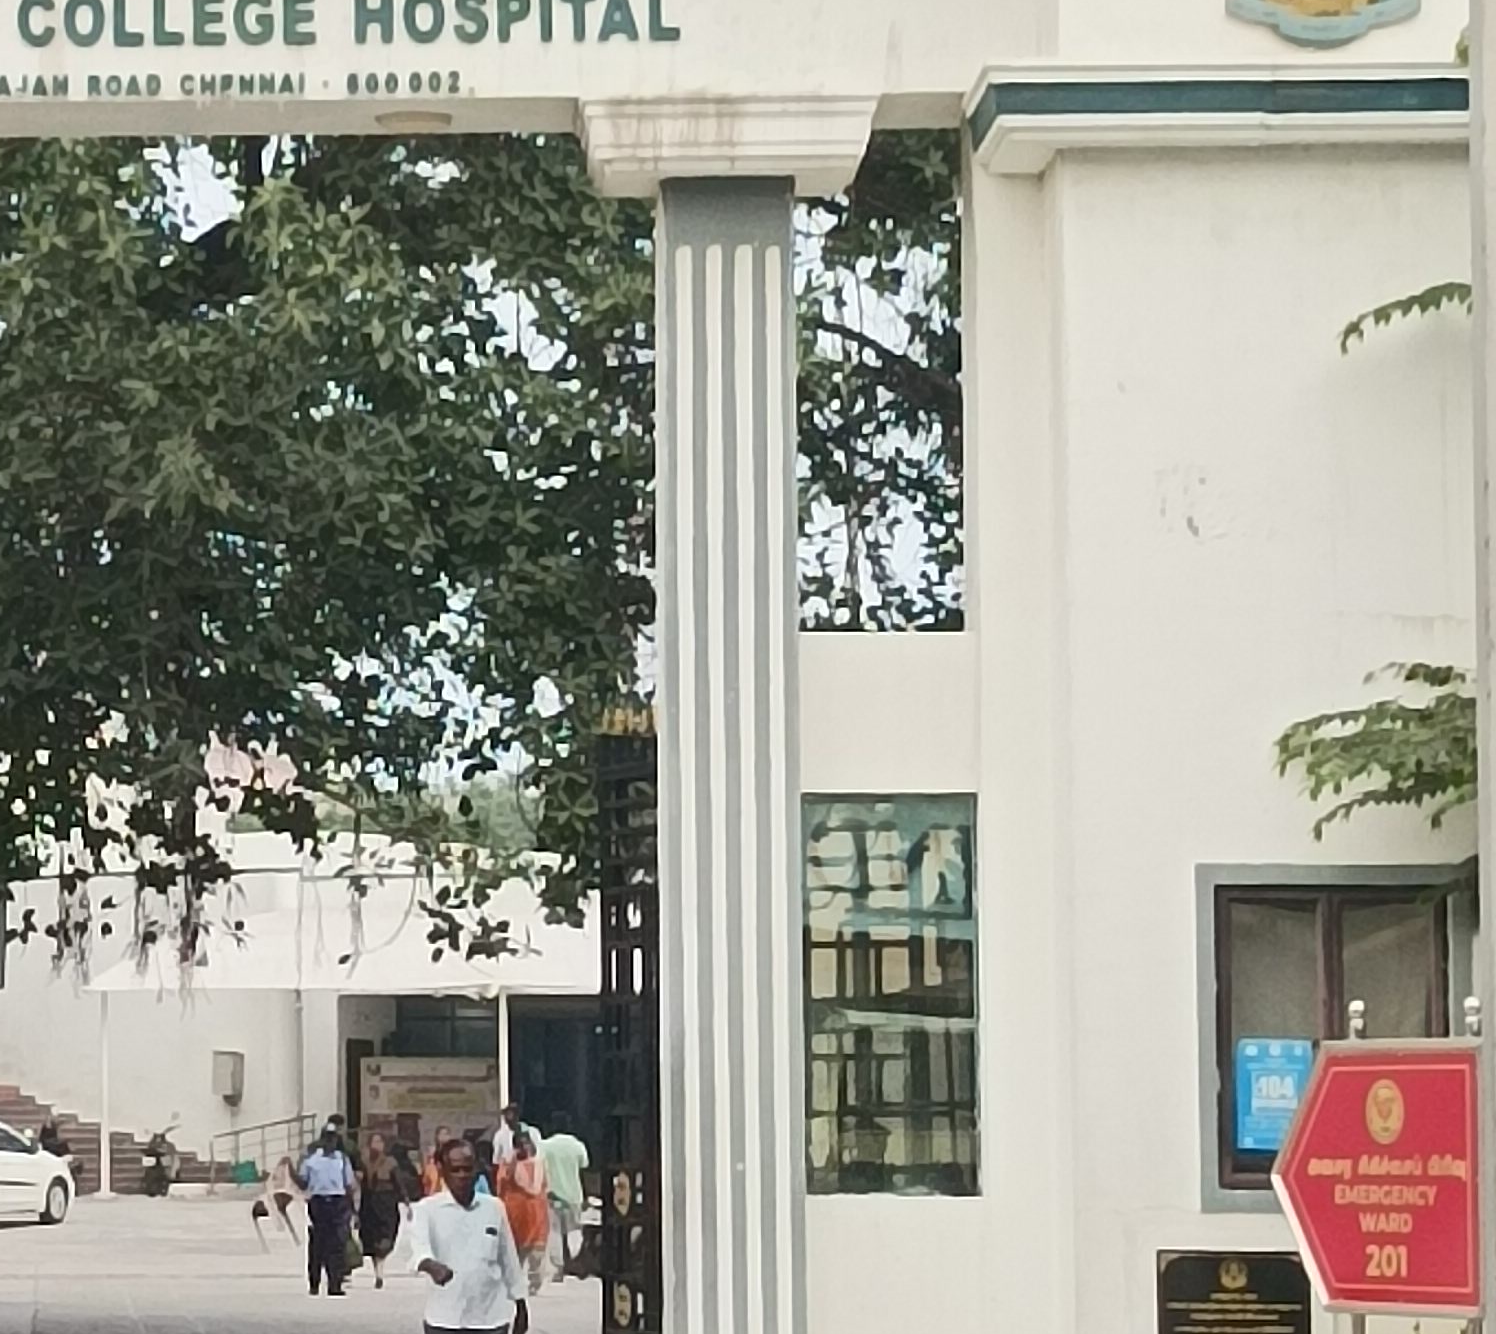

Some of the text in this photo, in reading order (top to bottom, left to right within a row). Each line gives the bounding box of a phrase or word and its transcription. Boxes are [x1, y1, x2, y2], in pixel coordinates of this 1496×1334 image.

[87, 73, 162, 97] ROAD
[1334, 1184, 1438, 1207] EMERGENCY
[1359, 1212, 1413, 1234] WARD
[1365, 1244, 1408, 1278] 201
